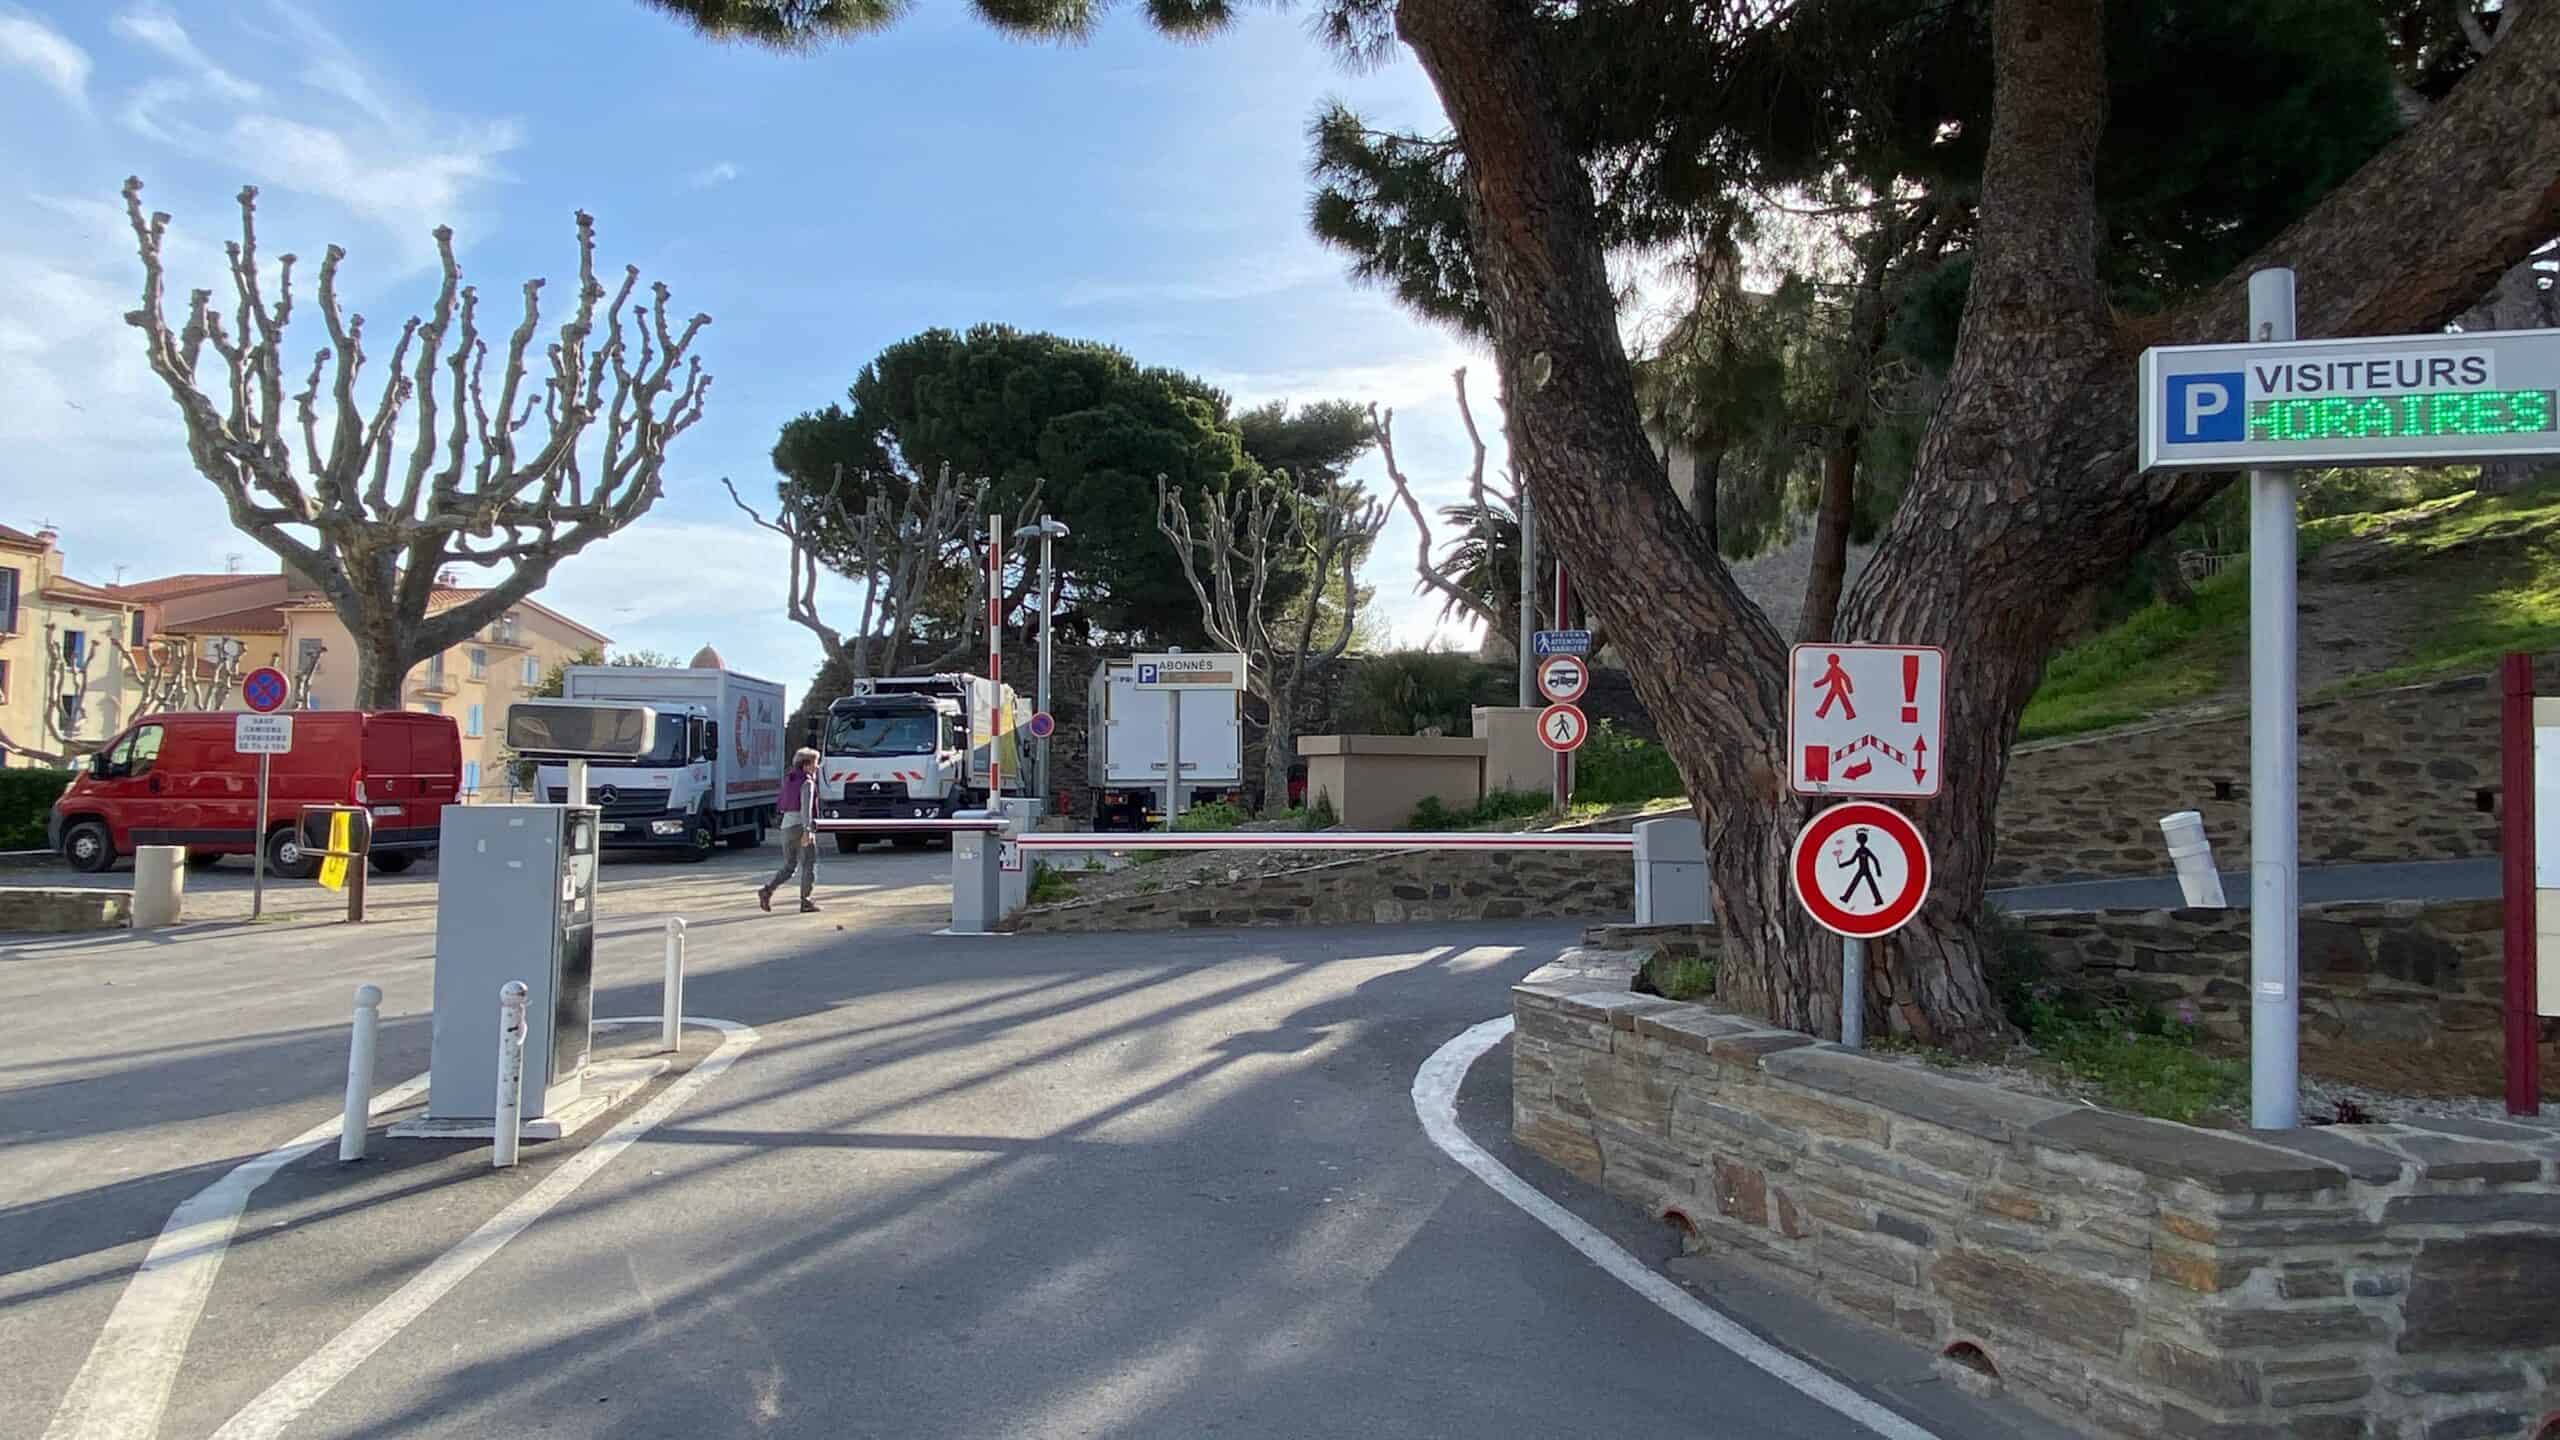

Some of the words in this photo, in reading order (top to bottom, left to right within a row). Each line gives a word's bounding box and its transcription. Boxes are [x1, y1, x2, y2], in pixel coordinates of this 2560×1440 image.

[2255, 356, 2488, 393] VISITEURS
[2185, 383, 2229, 435] P
[2249, 391, 2549, 440] HORAIRES
[1141, 665, 1154, 682] P
[1159, 659, 1214, 670] ABONNÉS
